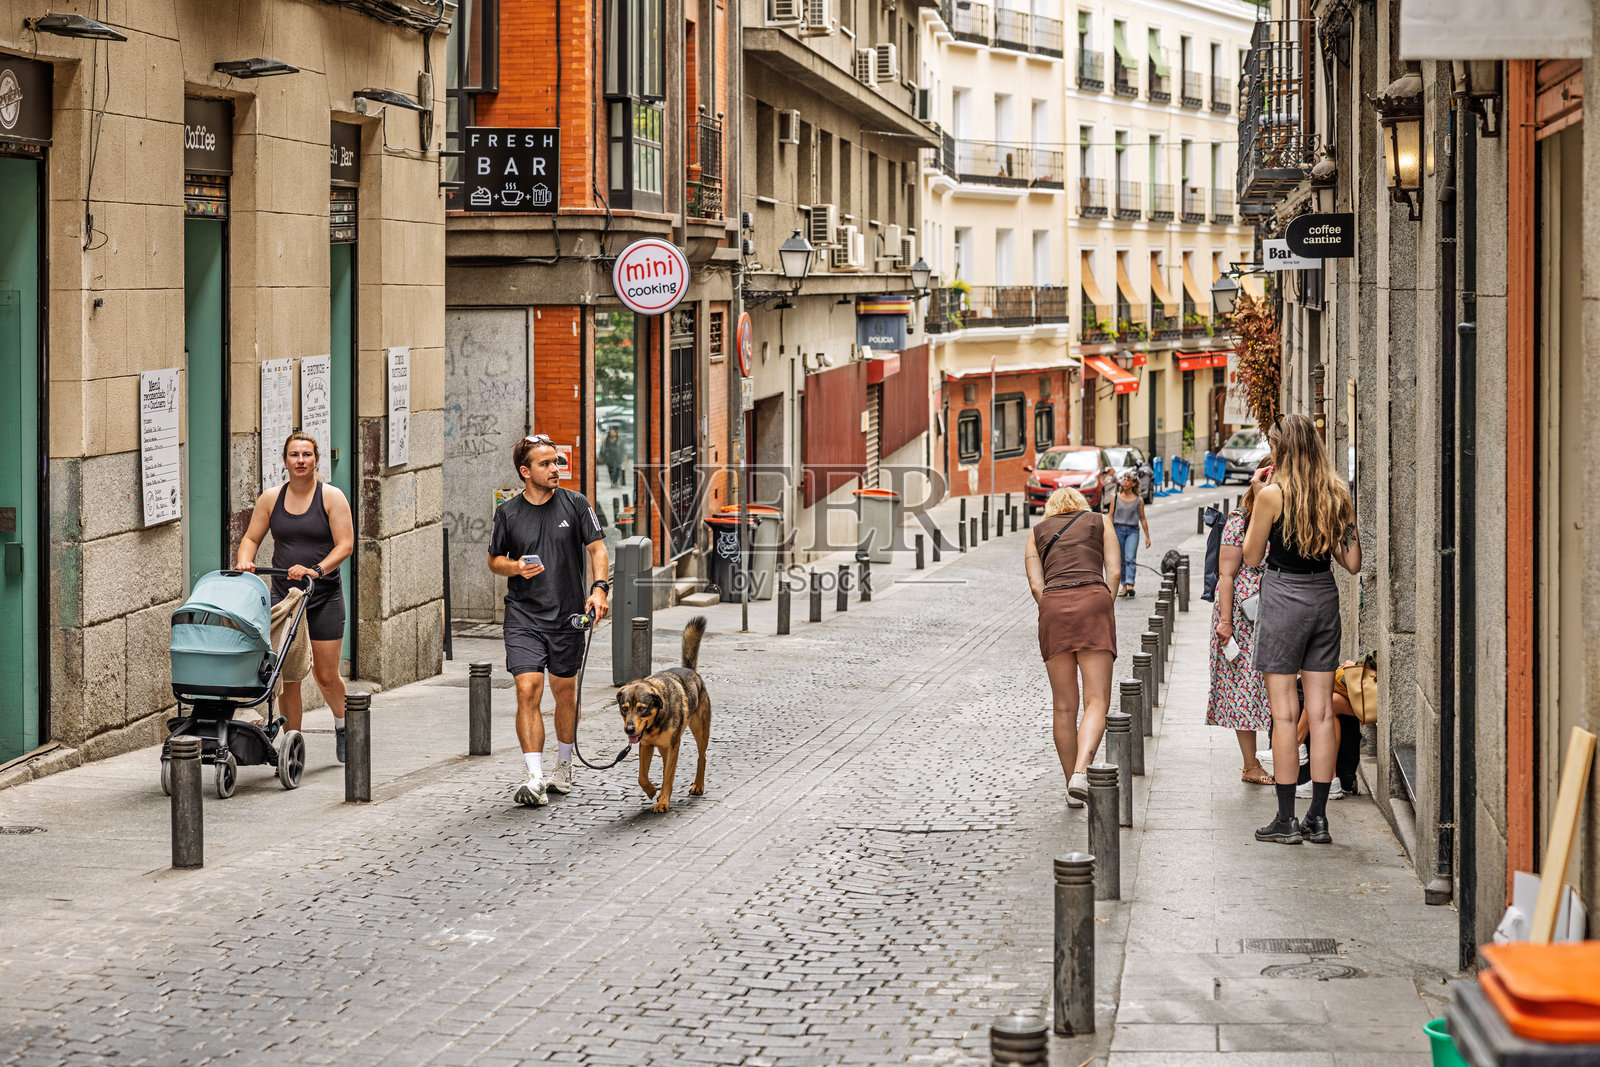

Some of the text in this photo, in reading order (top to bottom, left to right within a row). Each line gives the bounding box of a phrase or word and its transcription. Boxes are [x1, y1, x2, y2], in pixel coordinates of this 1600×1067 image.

[185, 125, 216, 151] Coffee
[471, 134, 553, 147] FRESH
[340, 146, 354, 166] Bar
[477, 157, 547, 175] BAR
[1308, 225, 1342, 235] coffee
[1303, 235, 1342, 244] cantine
[1269, 247, 1294, 259] Bar
[626, 255, 674, 281] mini
[627, 282, 677, 298] cooking
